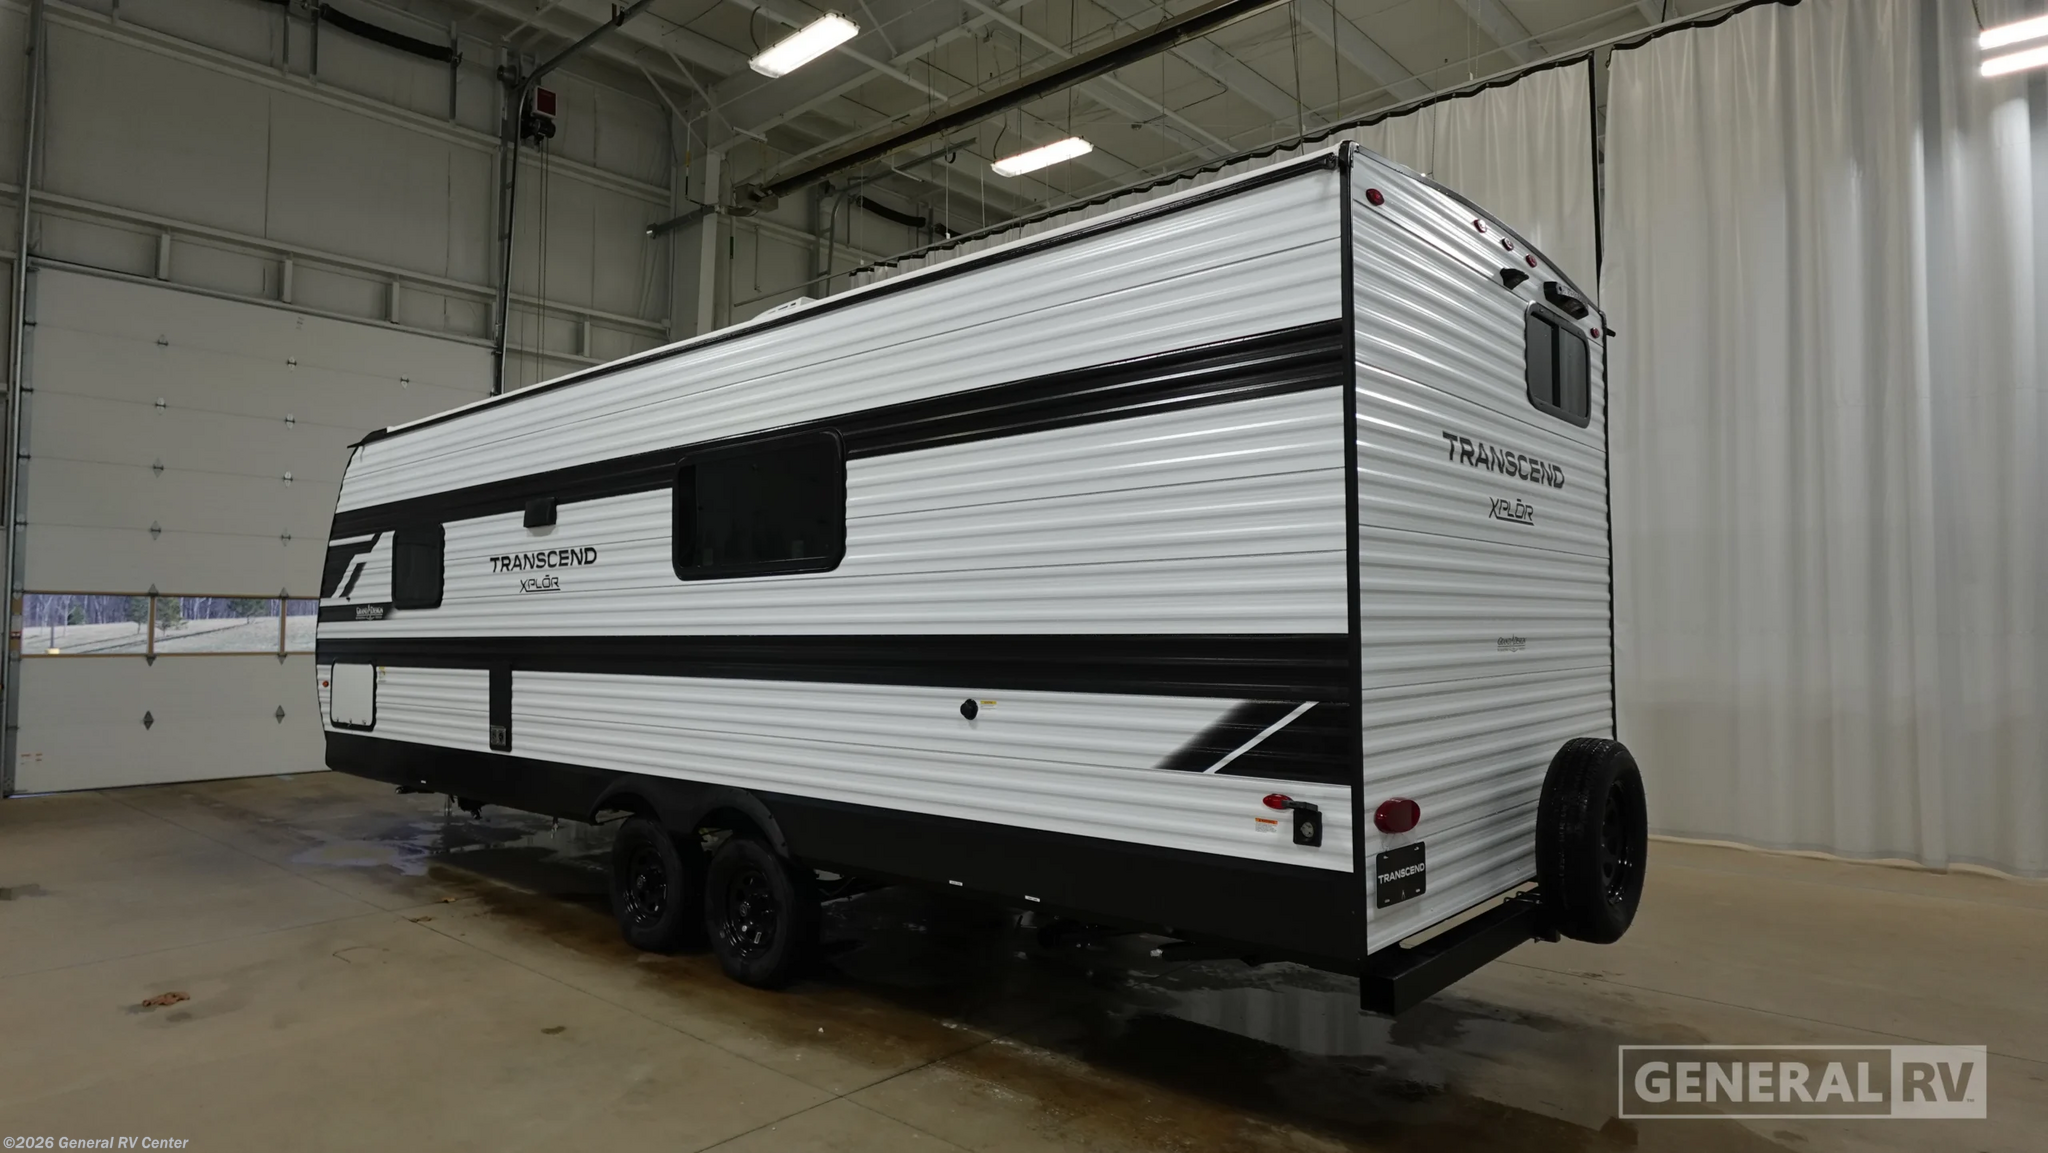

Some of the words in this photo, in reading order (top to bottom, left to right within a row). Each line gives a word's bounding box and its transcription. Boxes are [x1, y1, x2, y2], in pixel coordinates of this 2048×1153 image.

[1442, 430, 1565, 489] TRANSCEND
[489, 547, 597, 573] TRANSCEND
[1378, 862, 1425, 884] TRANSCEND
